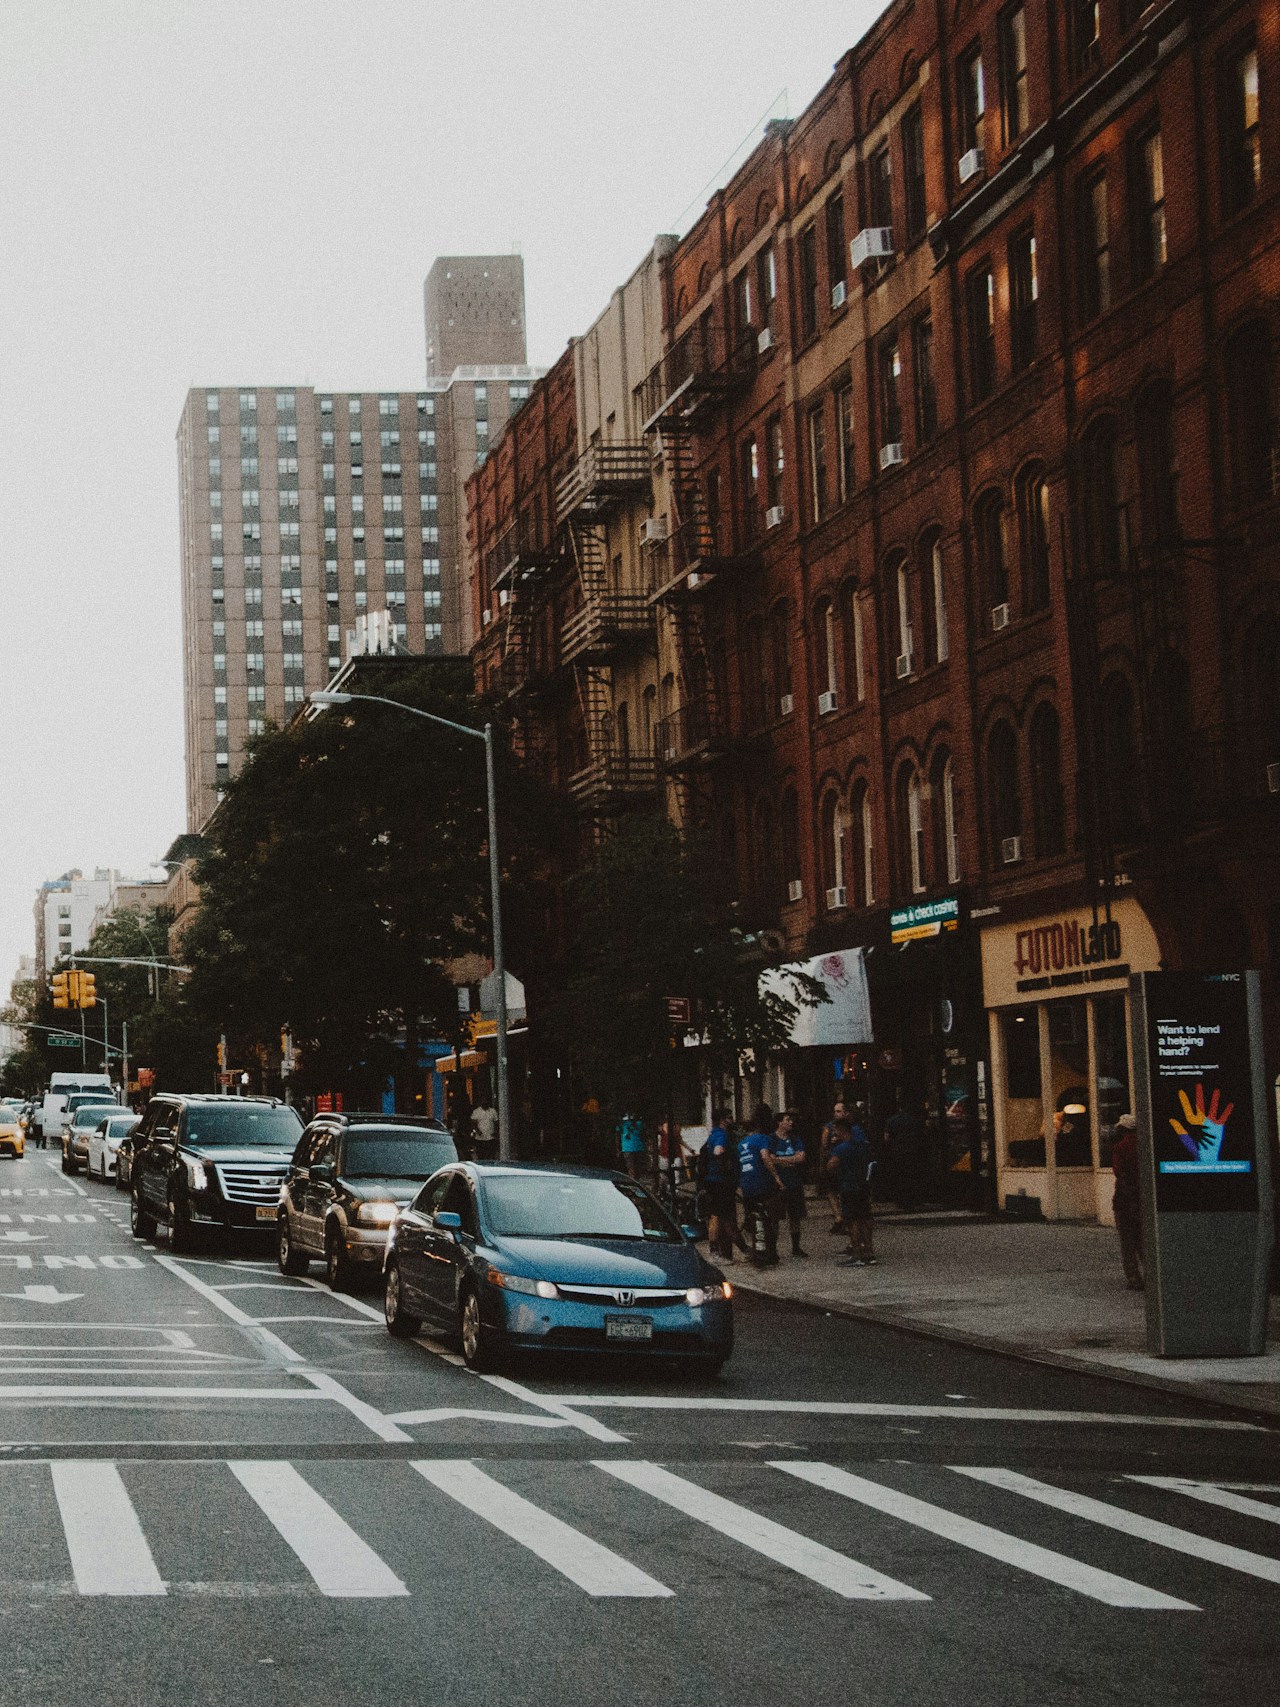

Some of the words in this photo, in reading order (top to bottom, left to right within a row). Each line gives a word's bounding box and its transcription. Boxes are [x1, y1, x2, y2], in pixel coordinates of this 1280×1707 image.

[1157, 1025, 1184, 1035] Want
[1185, 1026, 1197, 1034] to
[1198, 1024, 1221, 1034] lend
[1158, 1038, 1165, 1046] a
[1167, 1036, 1204, 1047] helping
[1158, 1047, 1190, 1056] hand?
